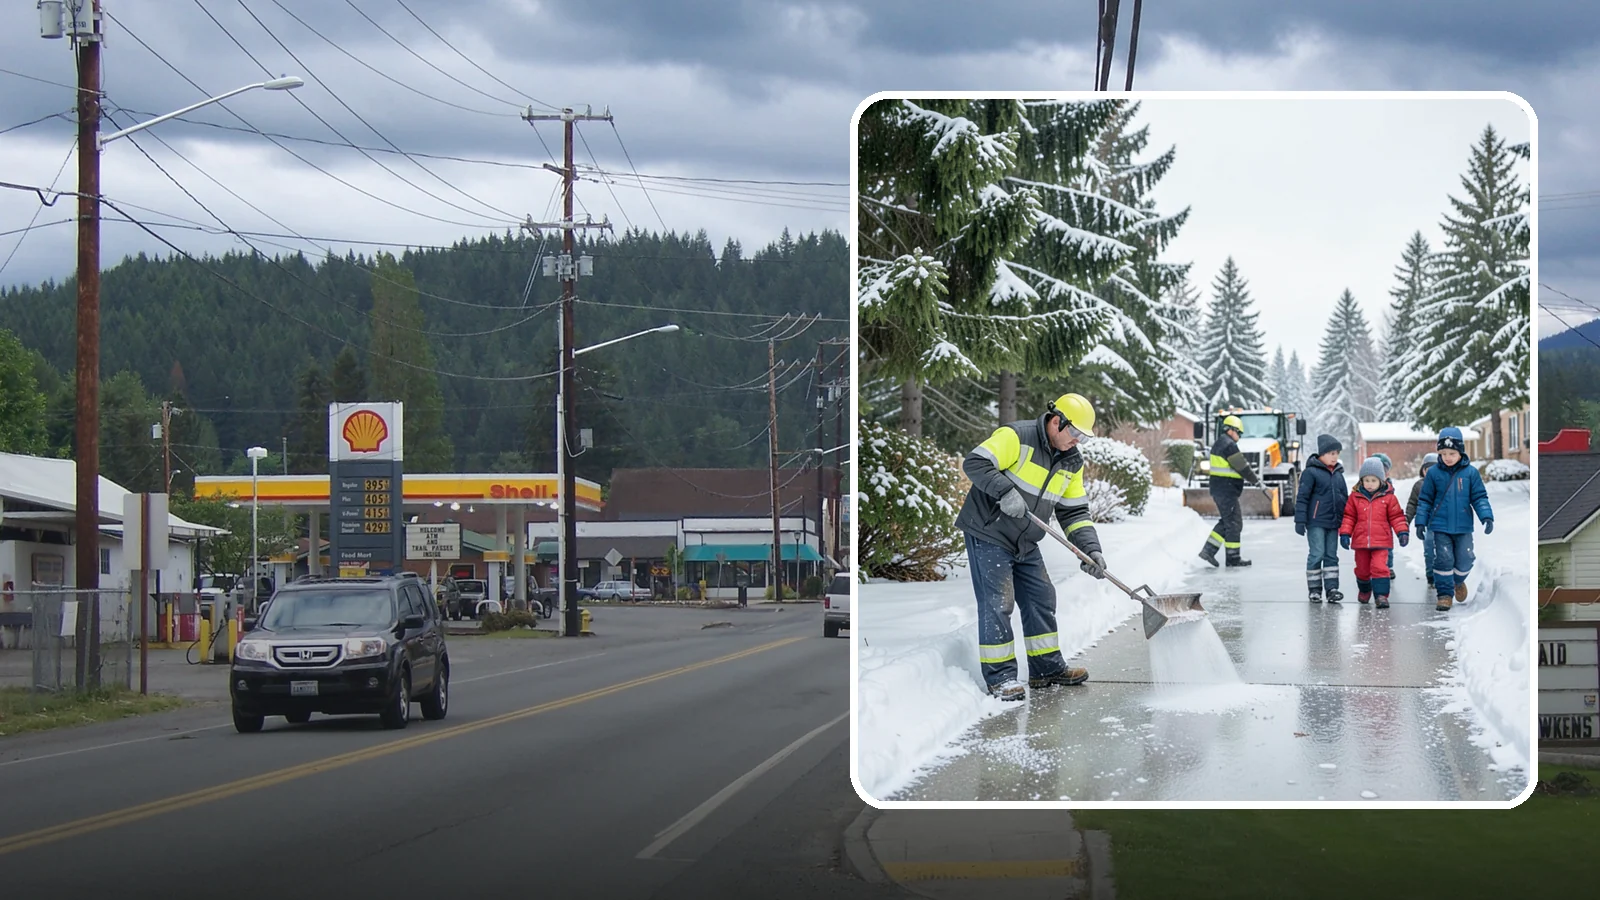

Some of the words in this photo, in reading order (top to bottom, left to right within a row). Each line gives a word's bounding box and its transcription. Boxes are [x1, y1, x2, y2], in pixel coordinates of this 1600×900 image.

[366, 480, 383, 490] 395
[490, 484, 547, 499] Shell
[366, 494, 383, 504] 405
[366, 508, 383, 518] 415
[366, 522, 383, 532] 429
